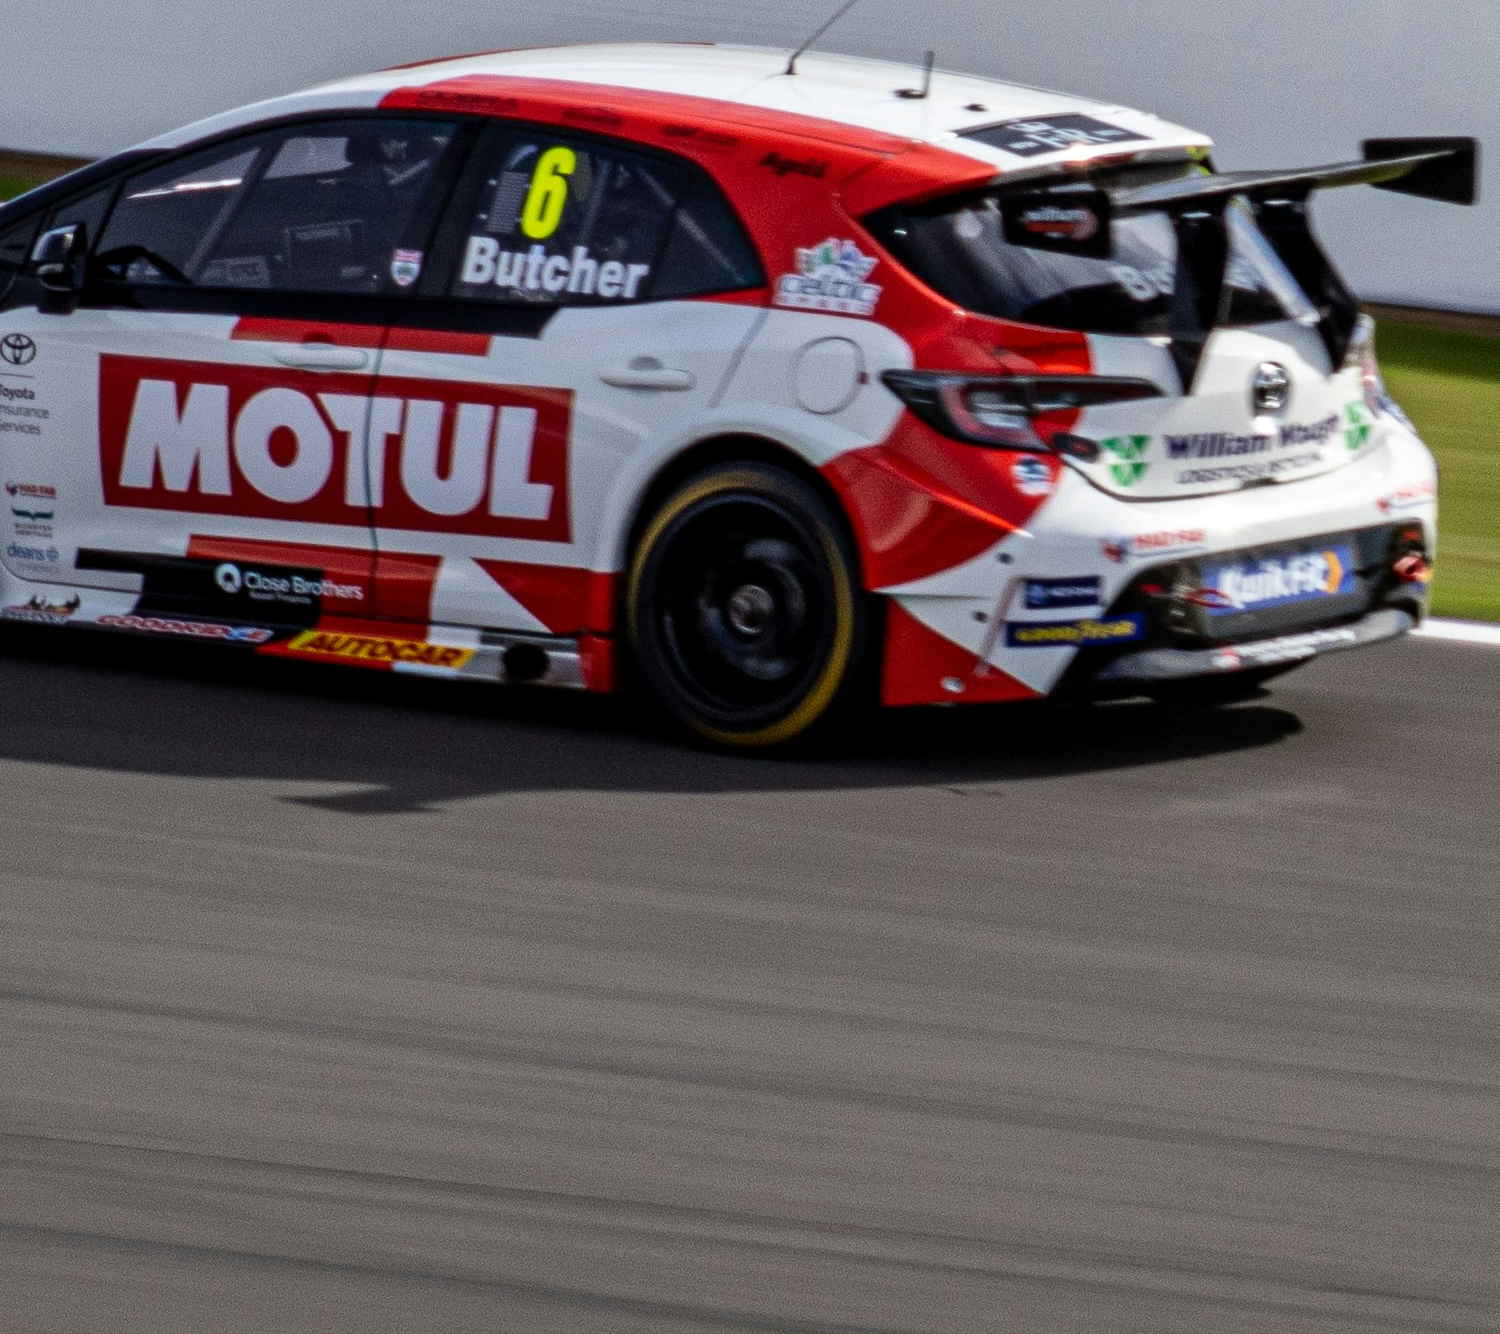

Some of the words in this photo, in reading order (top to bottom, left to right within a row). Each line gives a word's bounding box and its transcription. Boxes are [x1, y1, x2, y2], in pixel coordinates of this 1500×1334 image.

[521, 146, 577, 239] 6
[460, 235, 651, 298] Butcher
[118, 378, 554, 522] MOTUL
[243, 572, 290, 593] Close
[293, 575, 364, 601] Brothers
[310, 632, 463, 666] AUTOCAR
